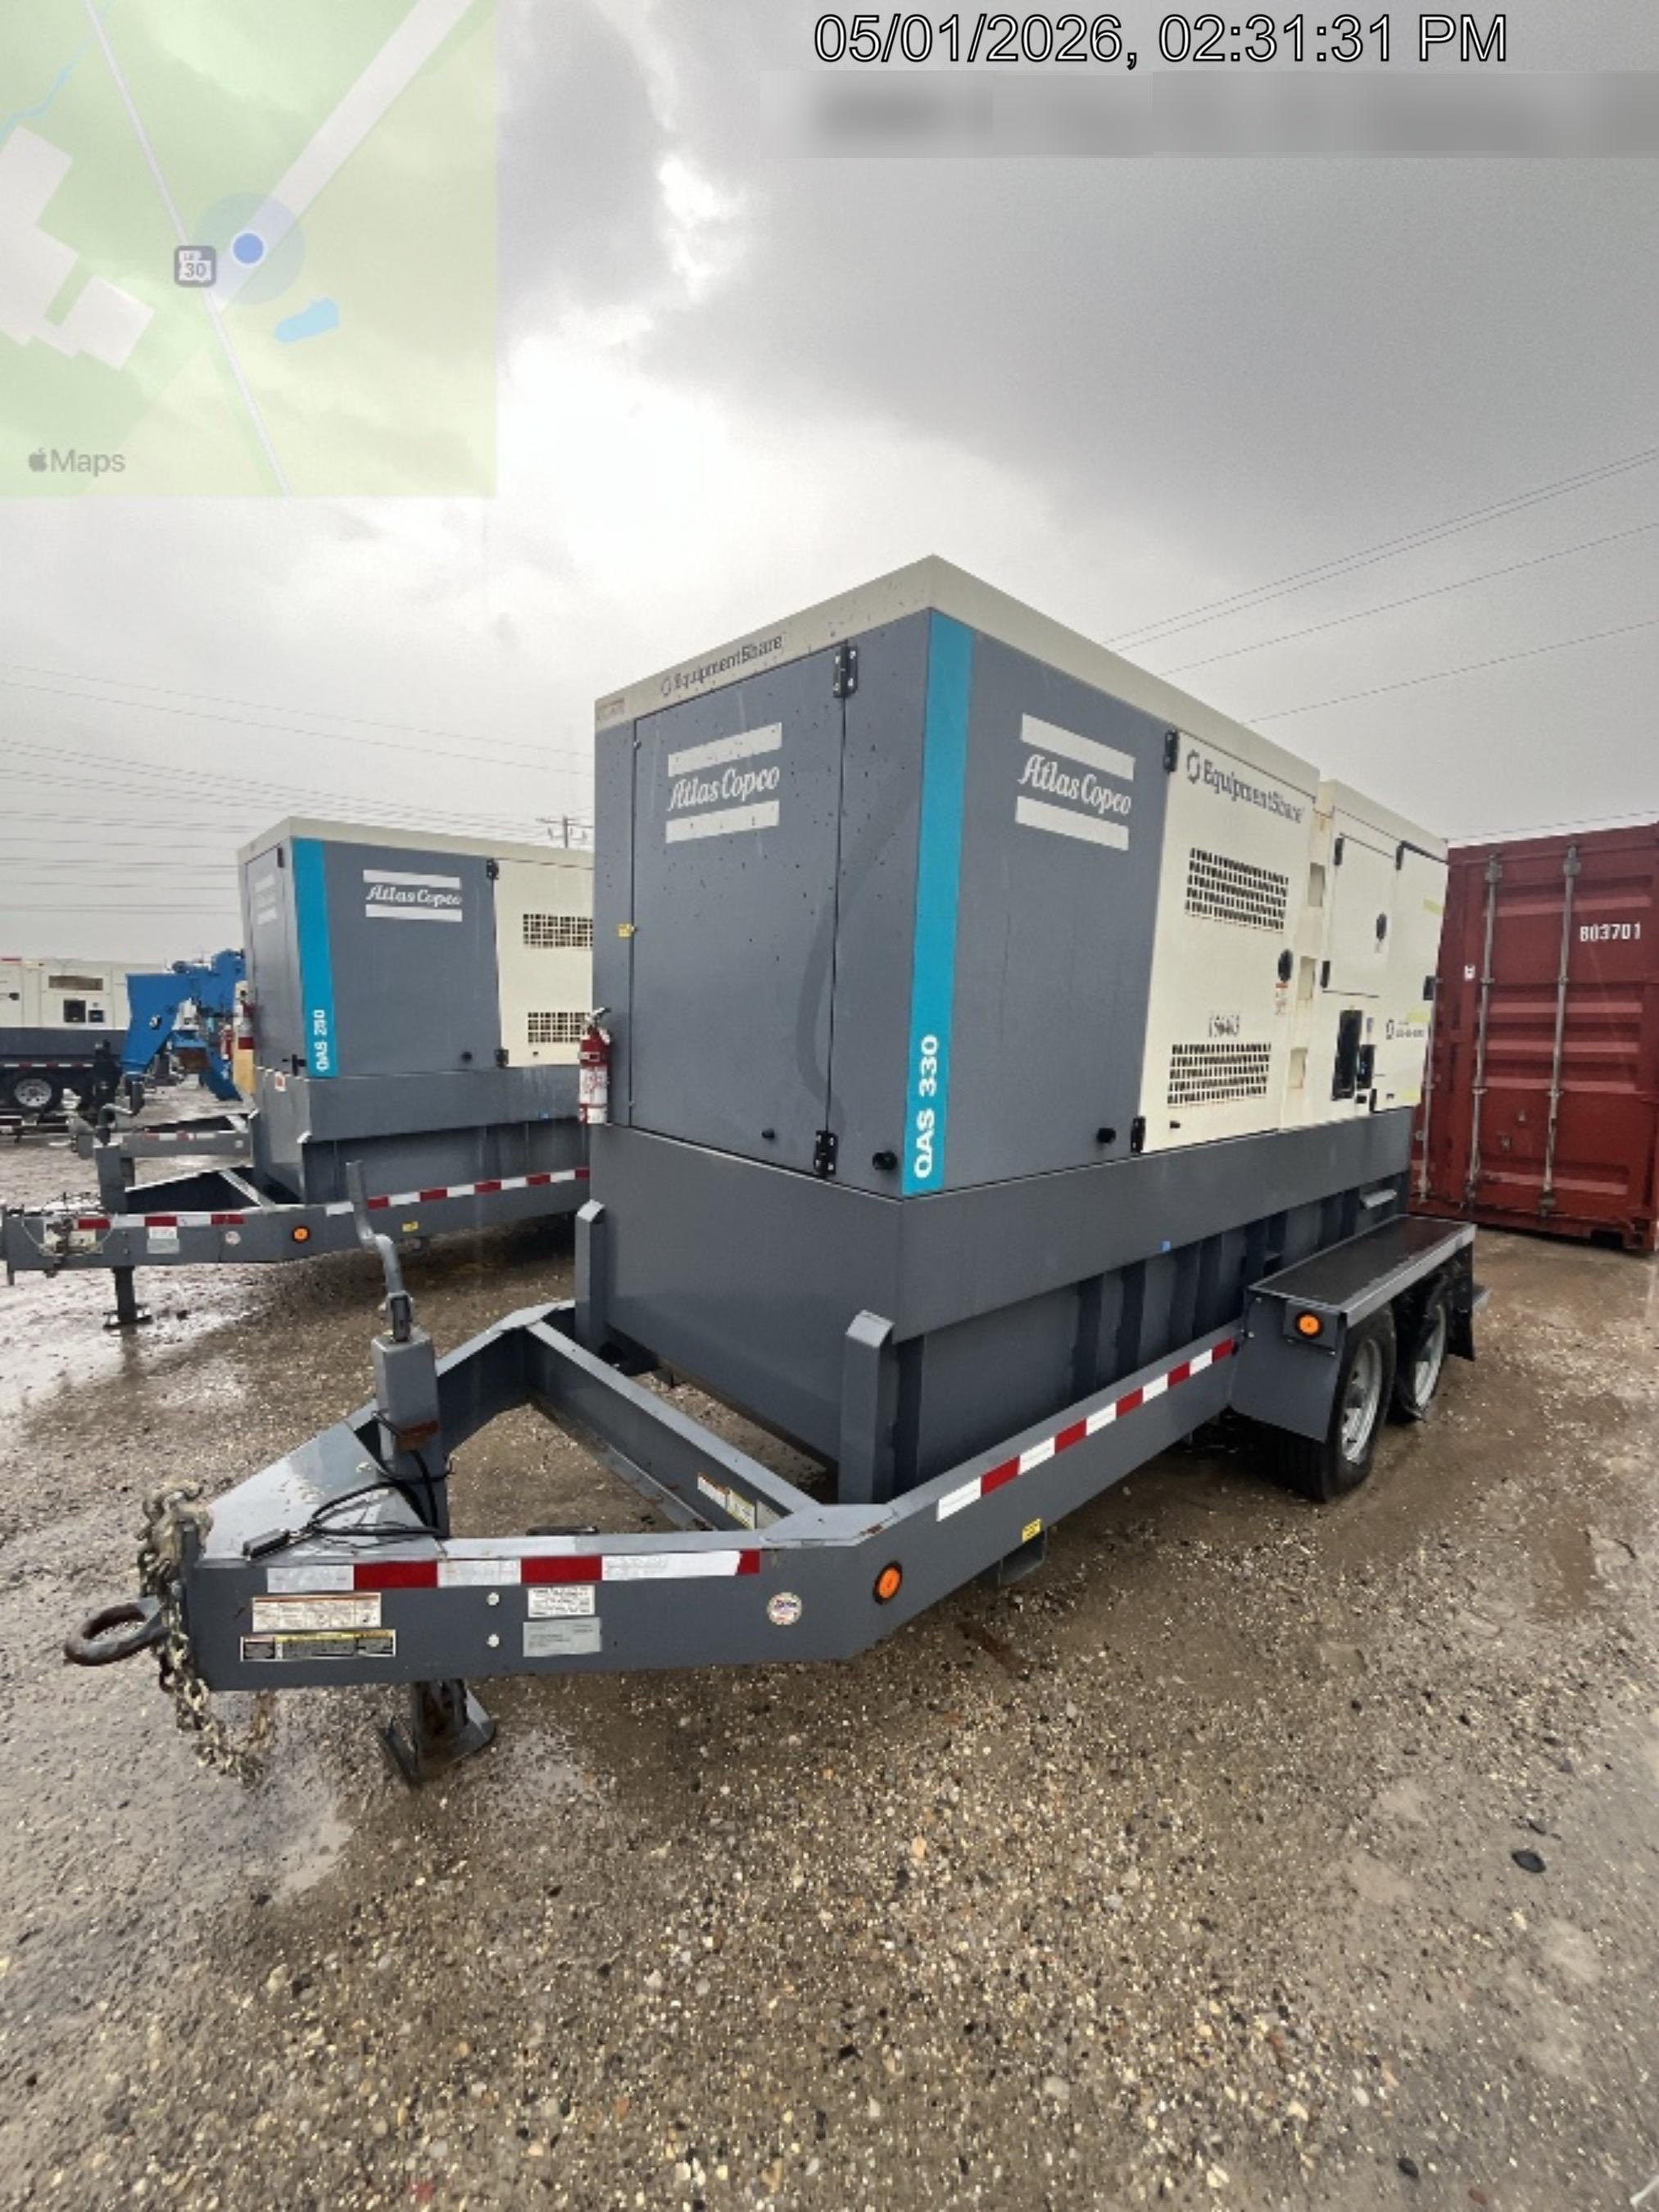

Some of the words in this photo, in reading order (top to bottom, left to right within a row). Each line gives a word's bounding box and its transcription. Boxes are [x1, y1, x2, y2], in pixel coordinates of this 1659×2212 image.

[666, 777, 719, 812] Atlas
[721, 766, 780, 802] Copco
[1018, 754, 1080, 800] Atlas
[1081, 773, 1132, 815] Copco
[365, 885, 415, 902] Atlas
[416, 889, 462, 908] Copco
[918, 1034, 940, 1098] 330
